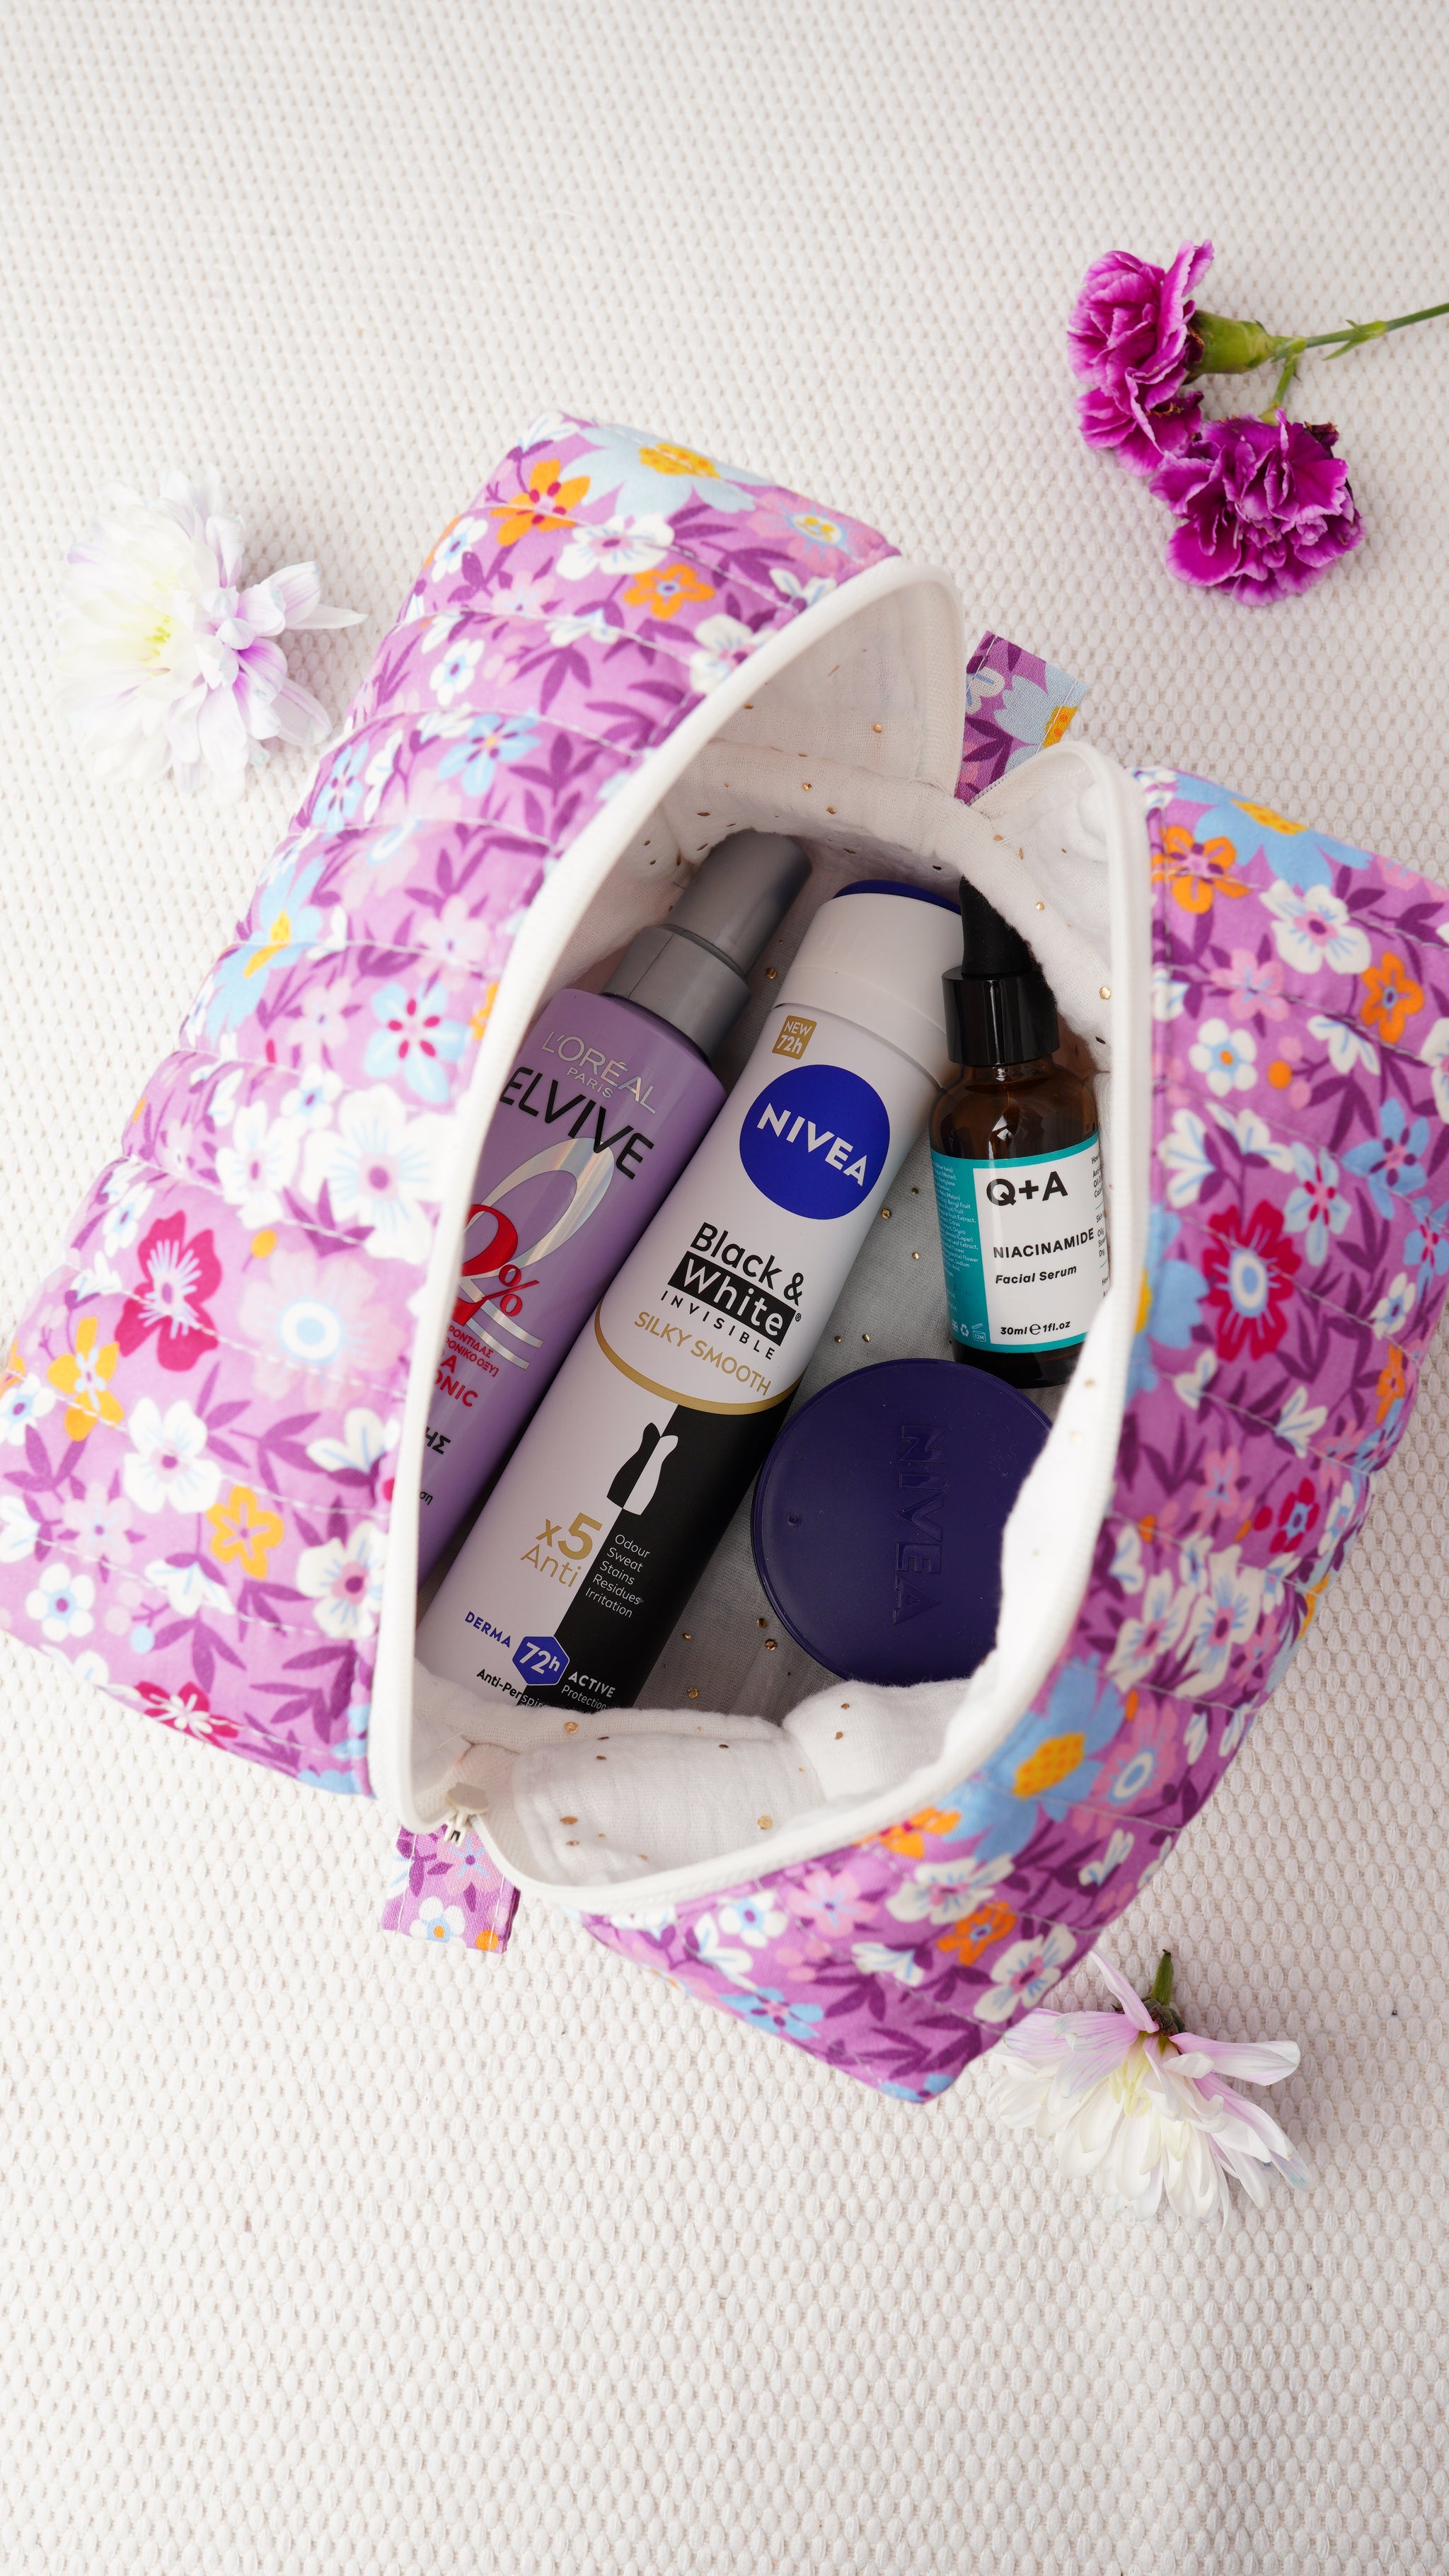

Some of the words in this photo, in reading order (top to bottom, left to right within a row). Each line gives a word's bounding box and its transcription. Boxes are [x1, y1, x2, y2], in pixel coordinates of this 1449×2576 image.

[777, 1034, 803, 1054] 72h
[784, 1020, 812, 1036] NEW
[541, 1030, 657, 1115] L'ORÉAL
[499, 1066, 654, 1180] ELVIVE
[756, 1103, 869, 1188] NIVEA
[986, 1171, 1068, 1206] Q+A
[993, 1227, 1094, 1259] NIACINAMIDE
[690, 1222, 783, 1293] Black
[783, 1272, 805, 1306] &
[995, 1272, 1036, 1284] Facial
[1039, 1265, 1077, 1282] Serum
[661, 1290, 775, 1360] INVISIBLE
[635, 1310, 693, 1347] SILKY
[691, 1338, 772, 1396] SMOOTH
[536, 1512, 603, 1560] x5
[894, 1424, 948, 1625] NIVEA
[607, 1547, 643, 1572] Sweat
[615, 1534, 650, 1558] Odour
[520, 1543, 583, 1588] Anti
[600, 1560, 635, 1585] Stains
[585, 1587, 632, 1618] Irritation
[592, 1573, 641, 1606] Residues
[464, 1611, 511, 1648] DERMA
[519, 1642, 560, 1674] 72h
[476, 1669, 548, 1708] Anti-Perspir
[567, 1671, 616, 1698] ACTIVE
